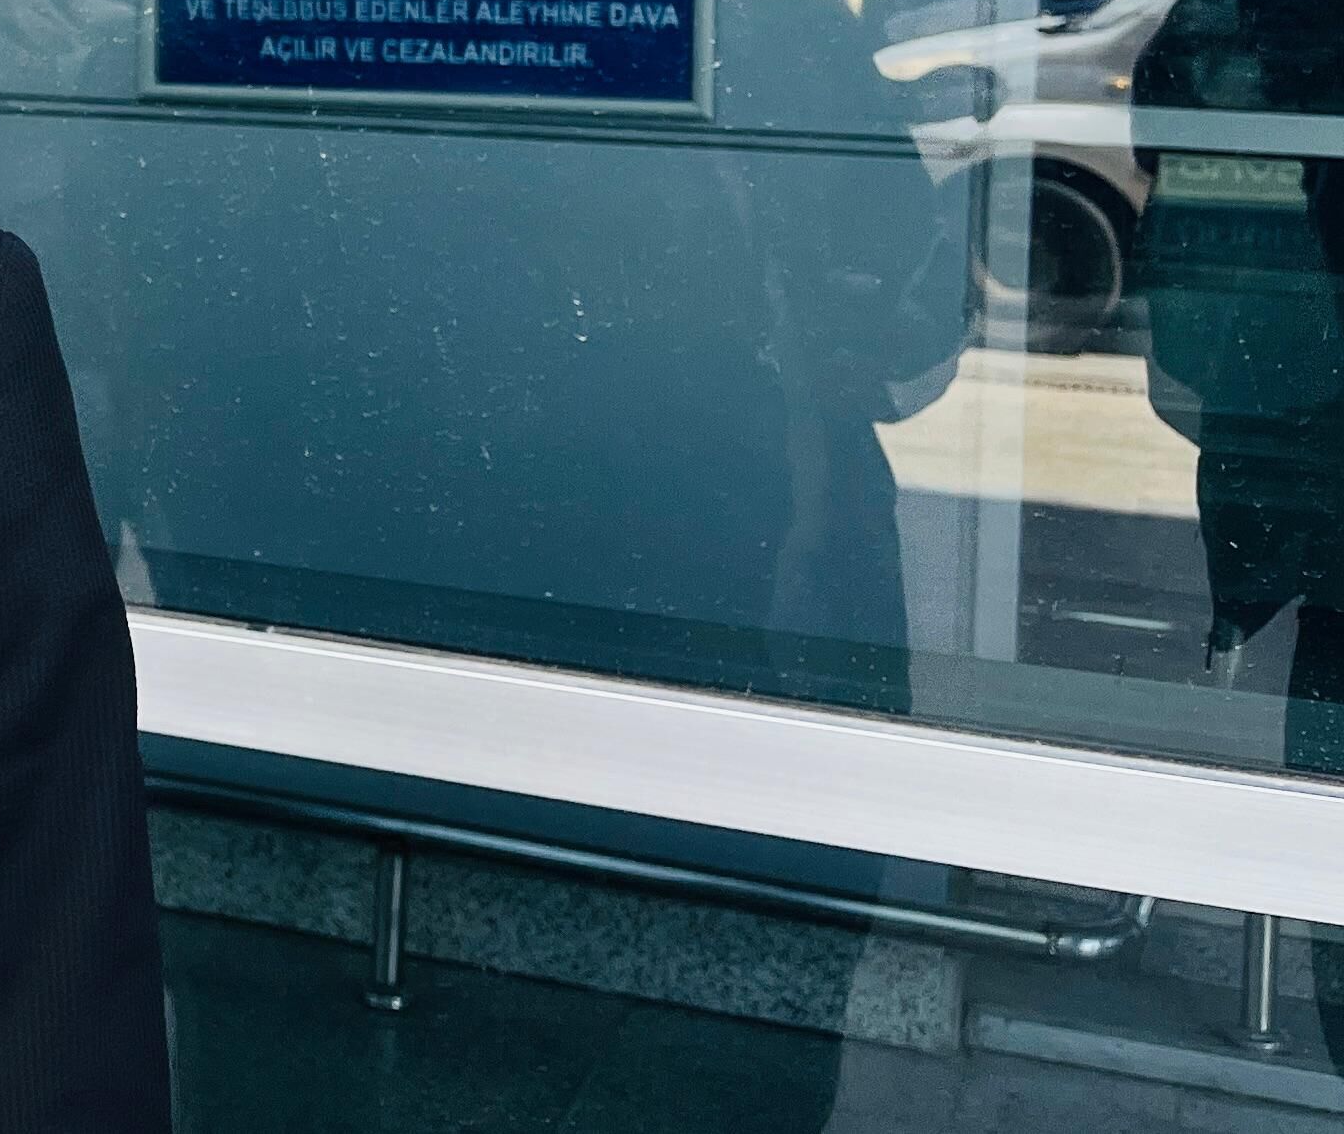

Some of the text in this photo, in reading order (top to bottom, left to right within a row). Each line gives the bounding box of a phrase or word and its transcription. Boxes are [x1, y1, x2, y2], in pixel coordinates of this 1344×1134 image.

[609, 2, 680, 29] DAVA
[260, 36, 337, 64] AÇILIR
[345, 37, 376, 62] VE
